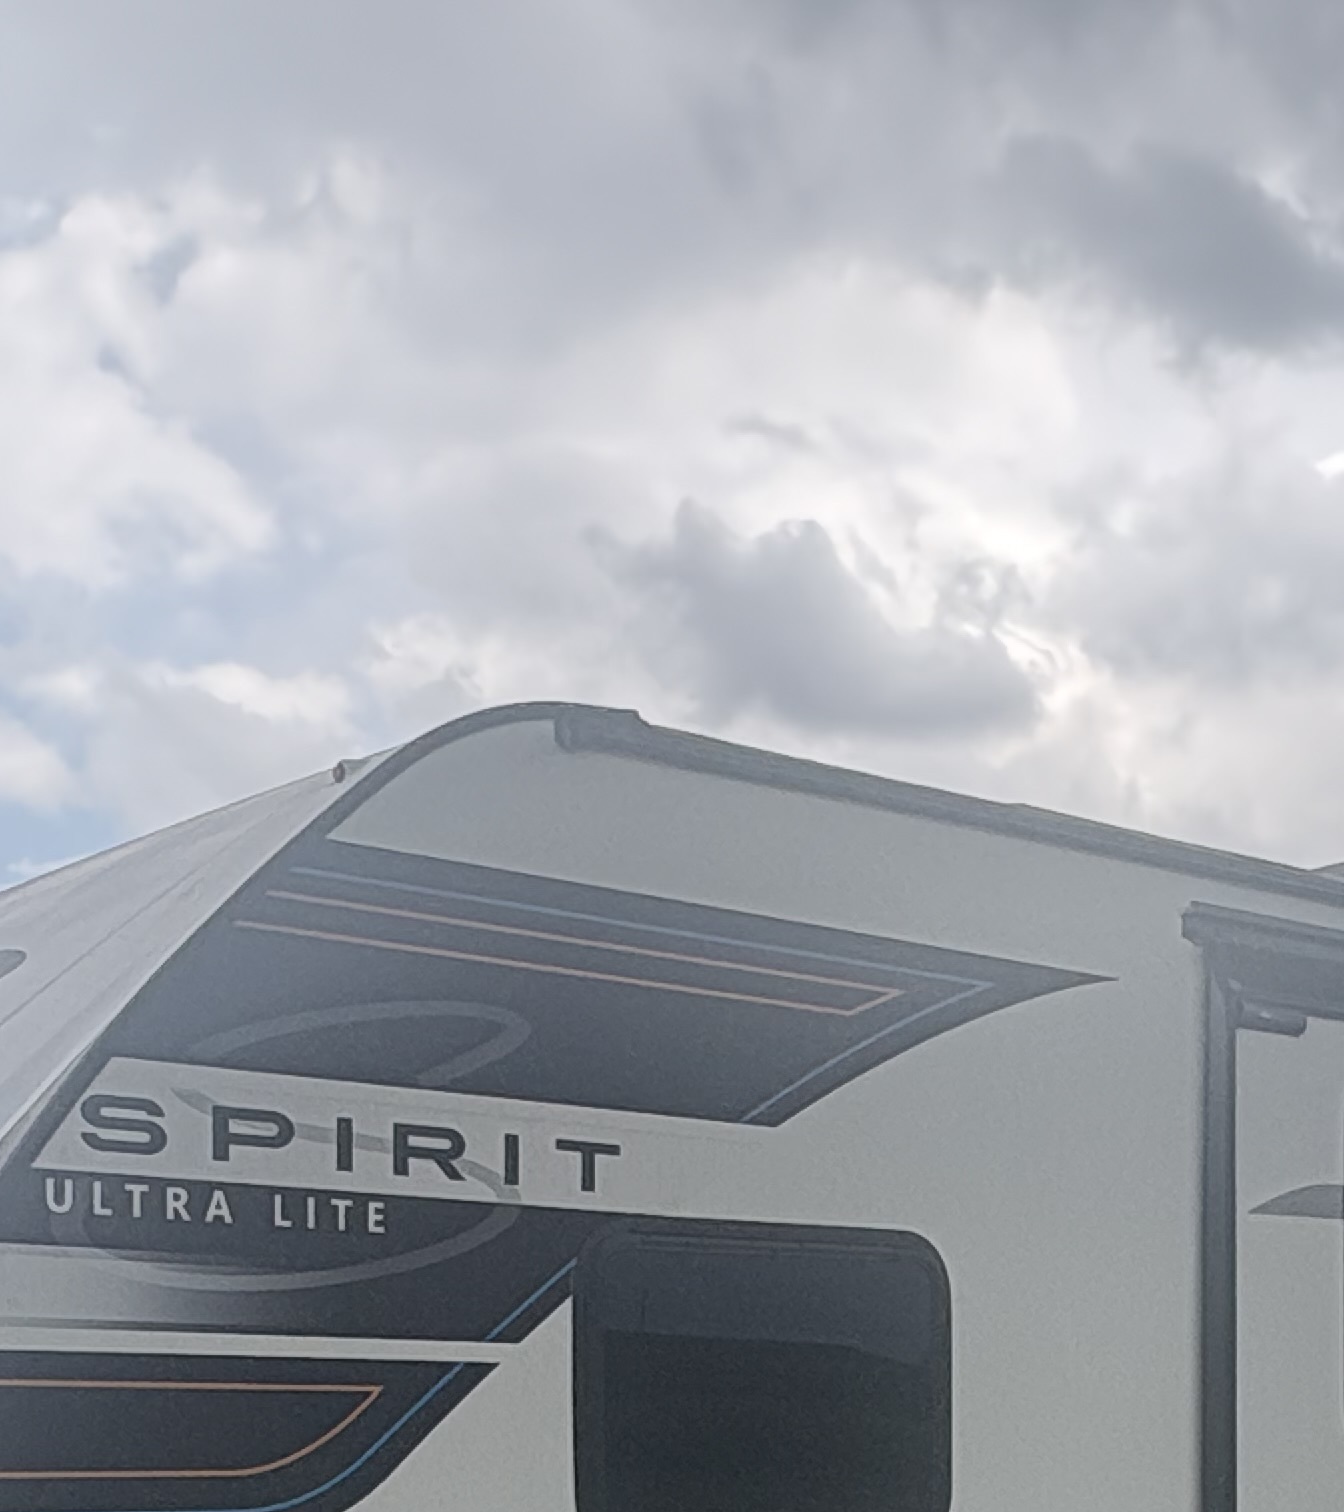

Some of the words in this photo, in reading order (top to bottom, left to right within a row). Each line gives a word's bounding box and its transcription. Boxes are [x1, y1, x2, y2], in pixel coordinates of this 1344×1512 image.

[80, 1094, 622, 1193] SPIRIT
[45, 1177, 234, 1224] ULTRA
[274, 1194, 386, 1234] LITE
